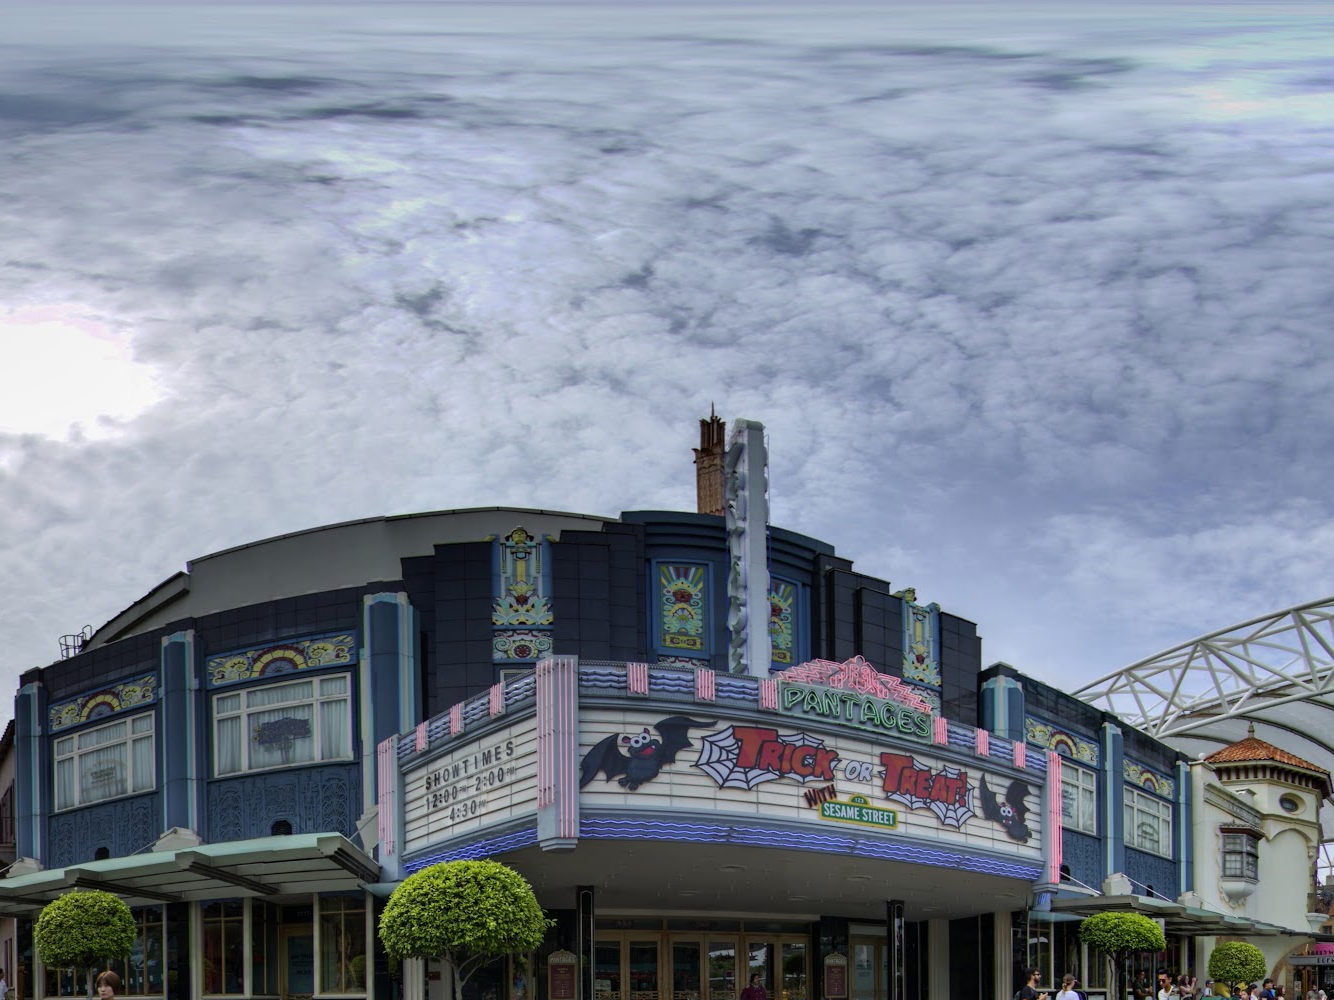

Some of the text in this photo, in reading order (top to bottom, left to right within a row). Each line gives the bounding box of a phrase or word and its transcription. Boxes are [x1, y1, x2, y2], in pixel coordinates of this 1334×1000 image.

[784, 687, 930, 737] PANTAGES
[425, 741, 514, 790] SHOWTIMES
[844, 760, 874, 782] OR
[803, 783, 837, 809] WITH
[823, 802, 895, 825] SESAME STREET
